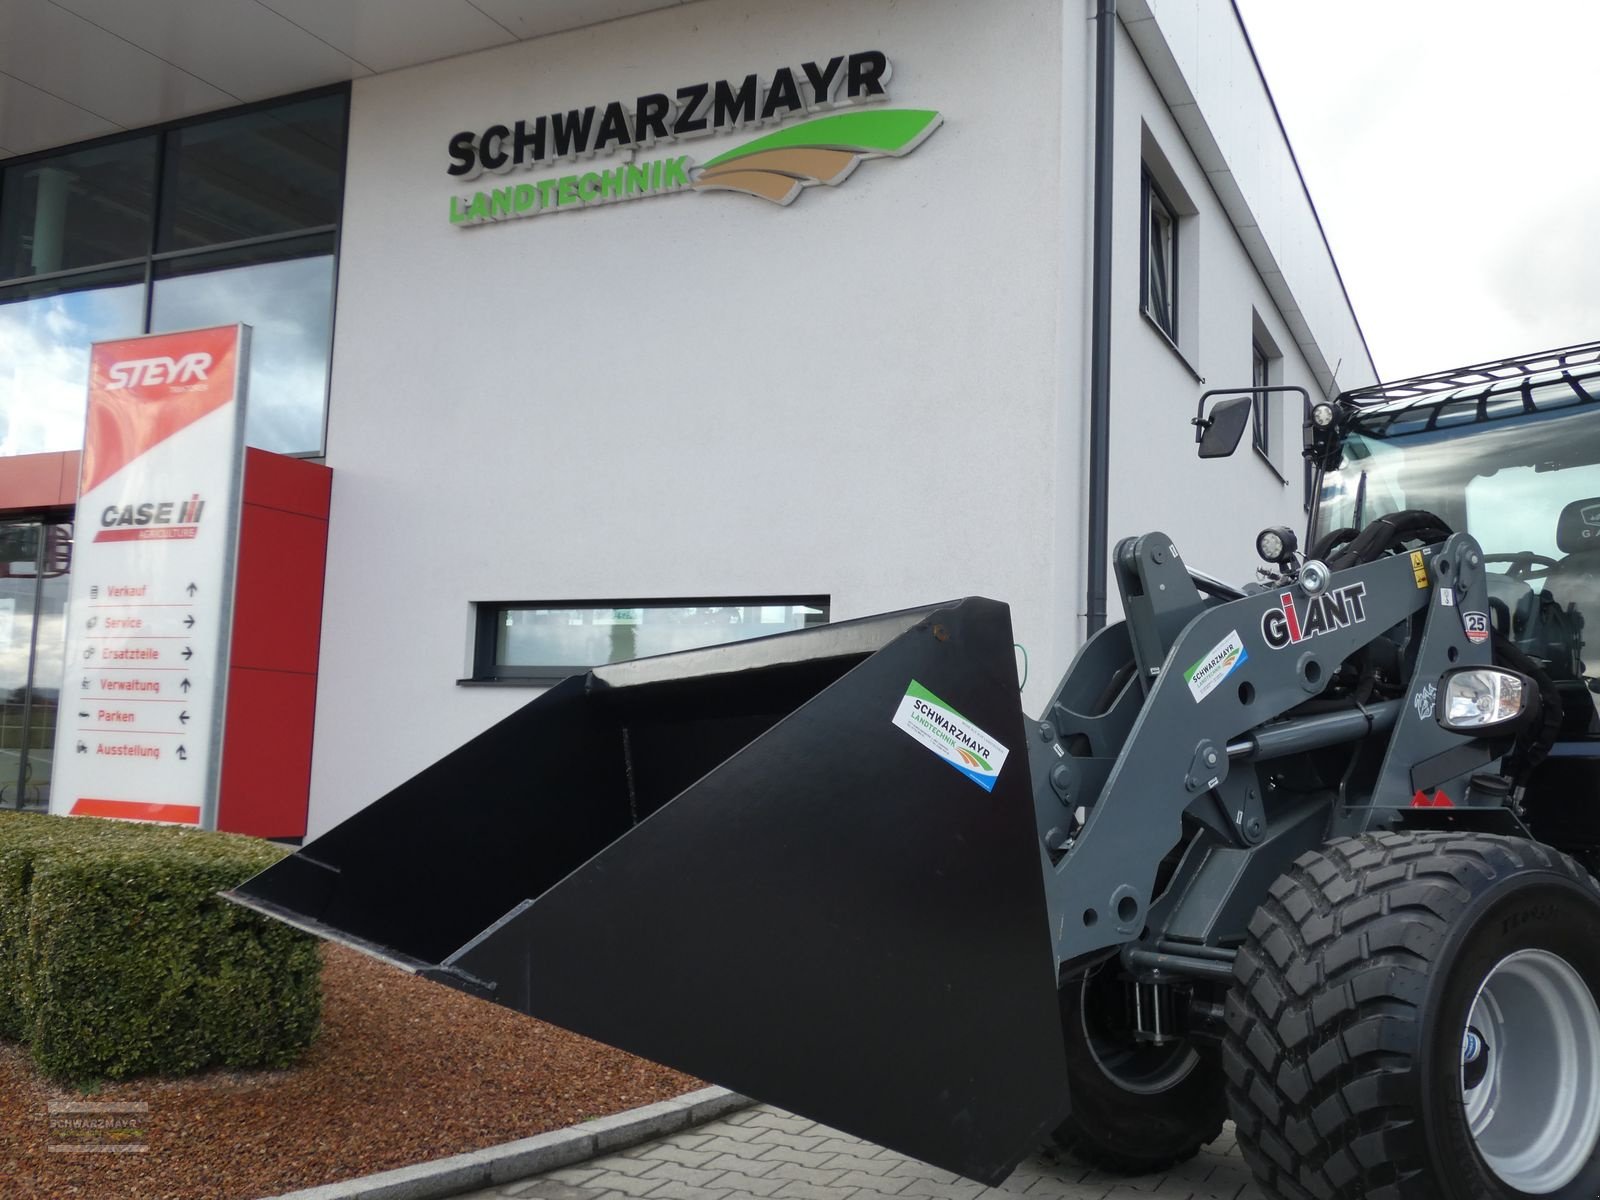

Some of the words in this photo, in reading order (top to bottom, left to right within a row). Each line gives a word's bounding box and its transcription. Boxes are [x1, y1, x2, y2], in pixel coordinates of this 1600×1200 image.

[446, 50, 888, 177] SCHWARZMAYR
[449, 155, 691, 225] LANDTECHNIK
[104, 352, 213, 391] STEYR
[101, 502, 174, 527] CASE
[107, 584, 147, 598] Verkauf
[105, 616, 143, 629] Service
[1469, 616, 1485, 631] 25
[102, 647, 160, 661] Ersatzteile
[1192, 643, 1235, 684] SCHWARZMAYR
[100, 678, 161, 694] Verwaltung
[97, 710, 135, 723] Parken
[911, 711, 957, 748] LANDTECHNIK
[913, 699, 990, 760] SCHWARZMAYR
[96, 743, 161, 760] Ausstellung
